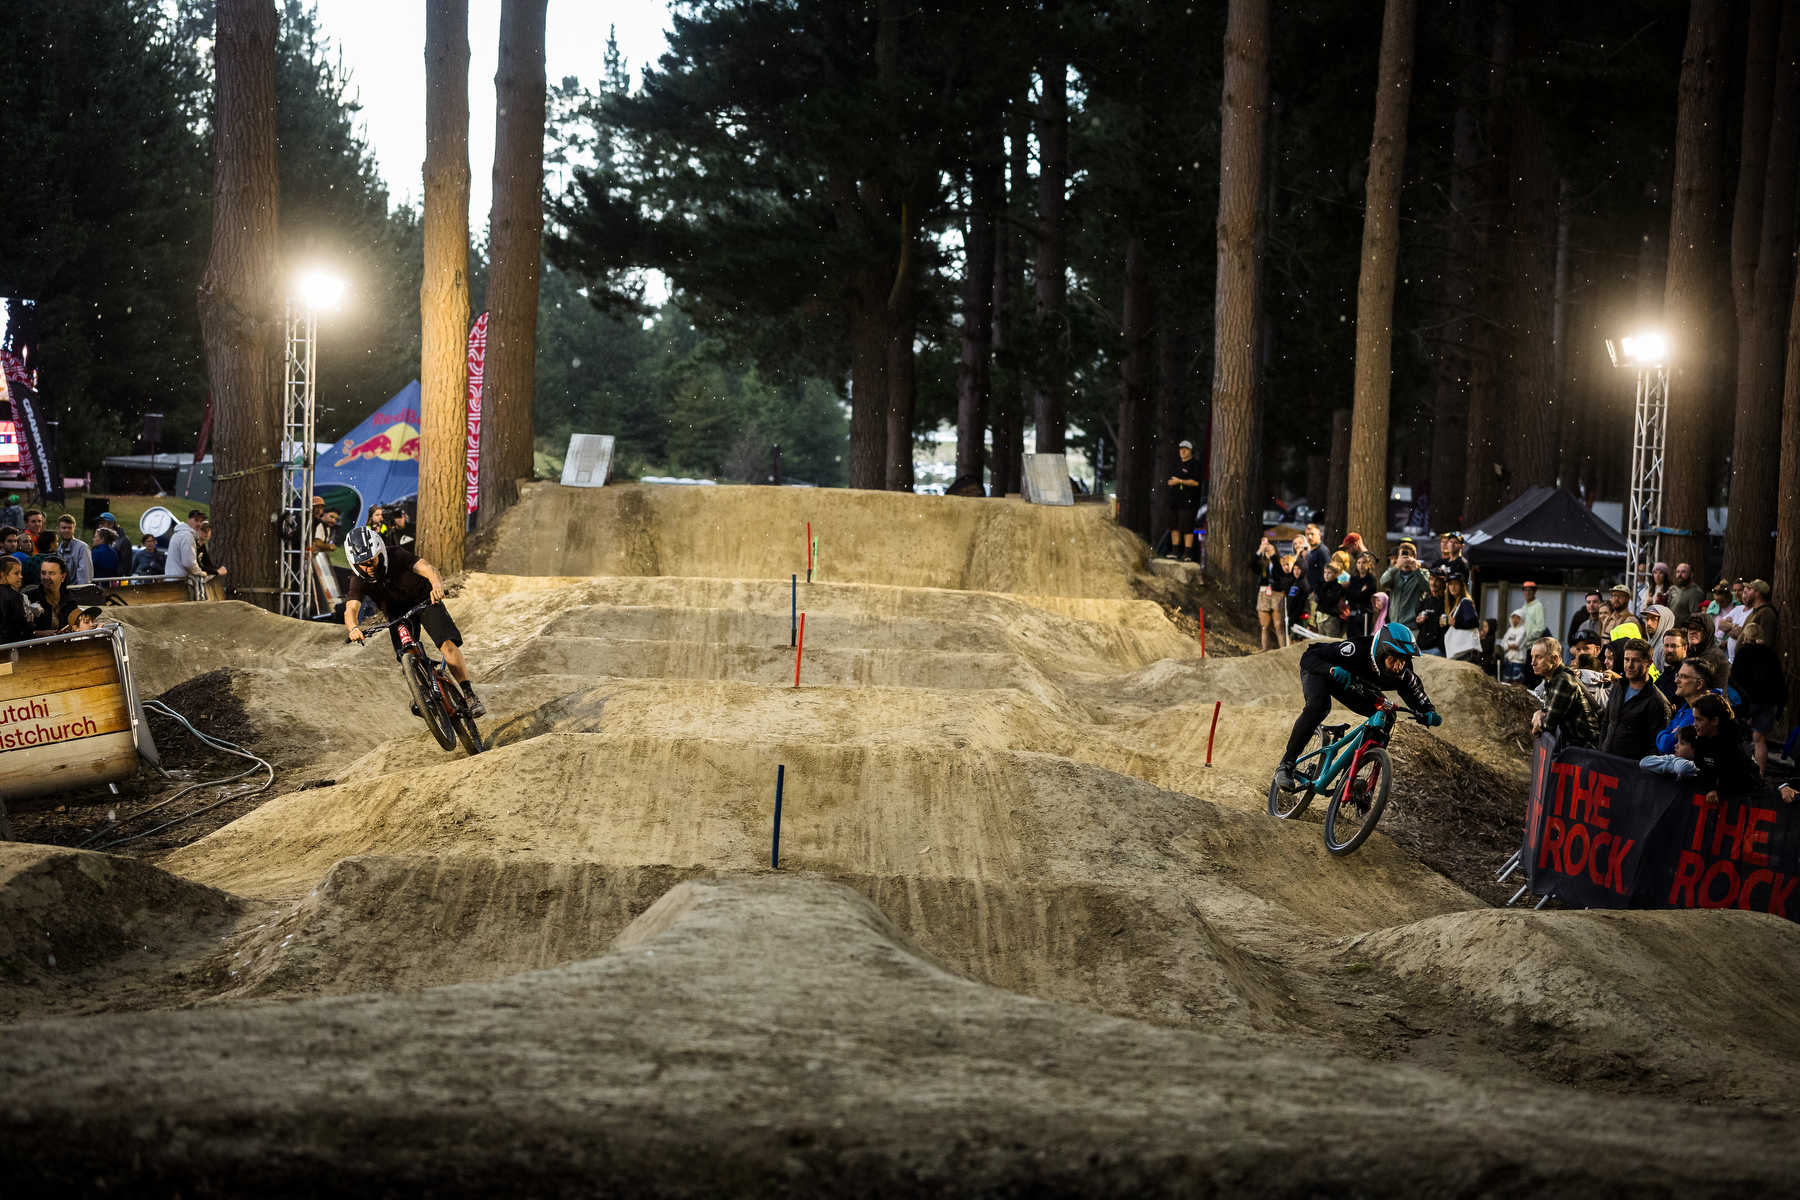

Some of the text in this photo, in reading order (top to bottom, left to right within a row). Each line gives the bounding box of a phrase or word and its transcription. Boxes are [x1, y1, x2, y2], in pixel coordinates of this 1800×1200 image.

[1551, 762, 1619, 829] THE
[1692, 794, 1777, 867] THE
[1667, 850, 1800, 919] ROCK
